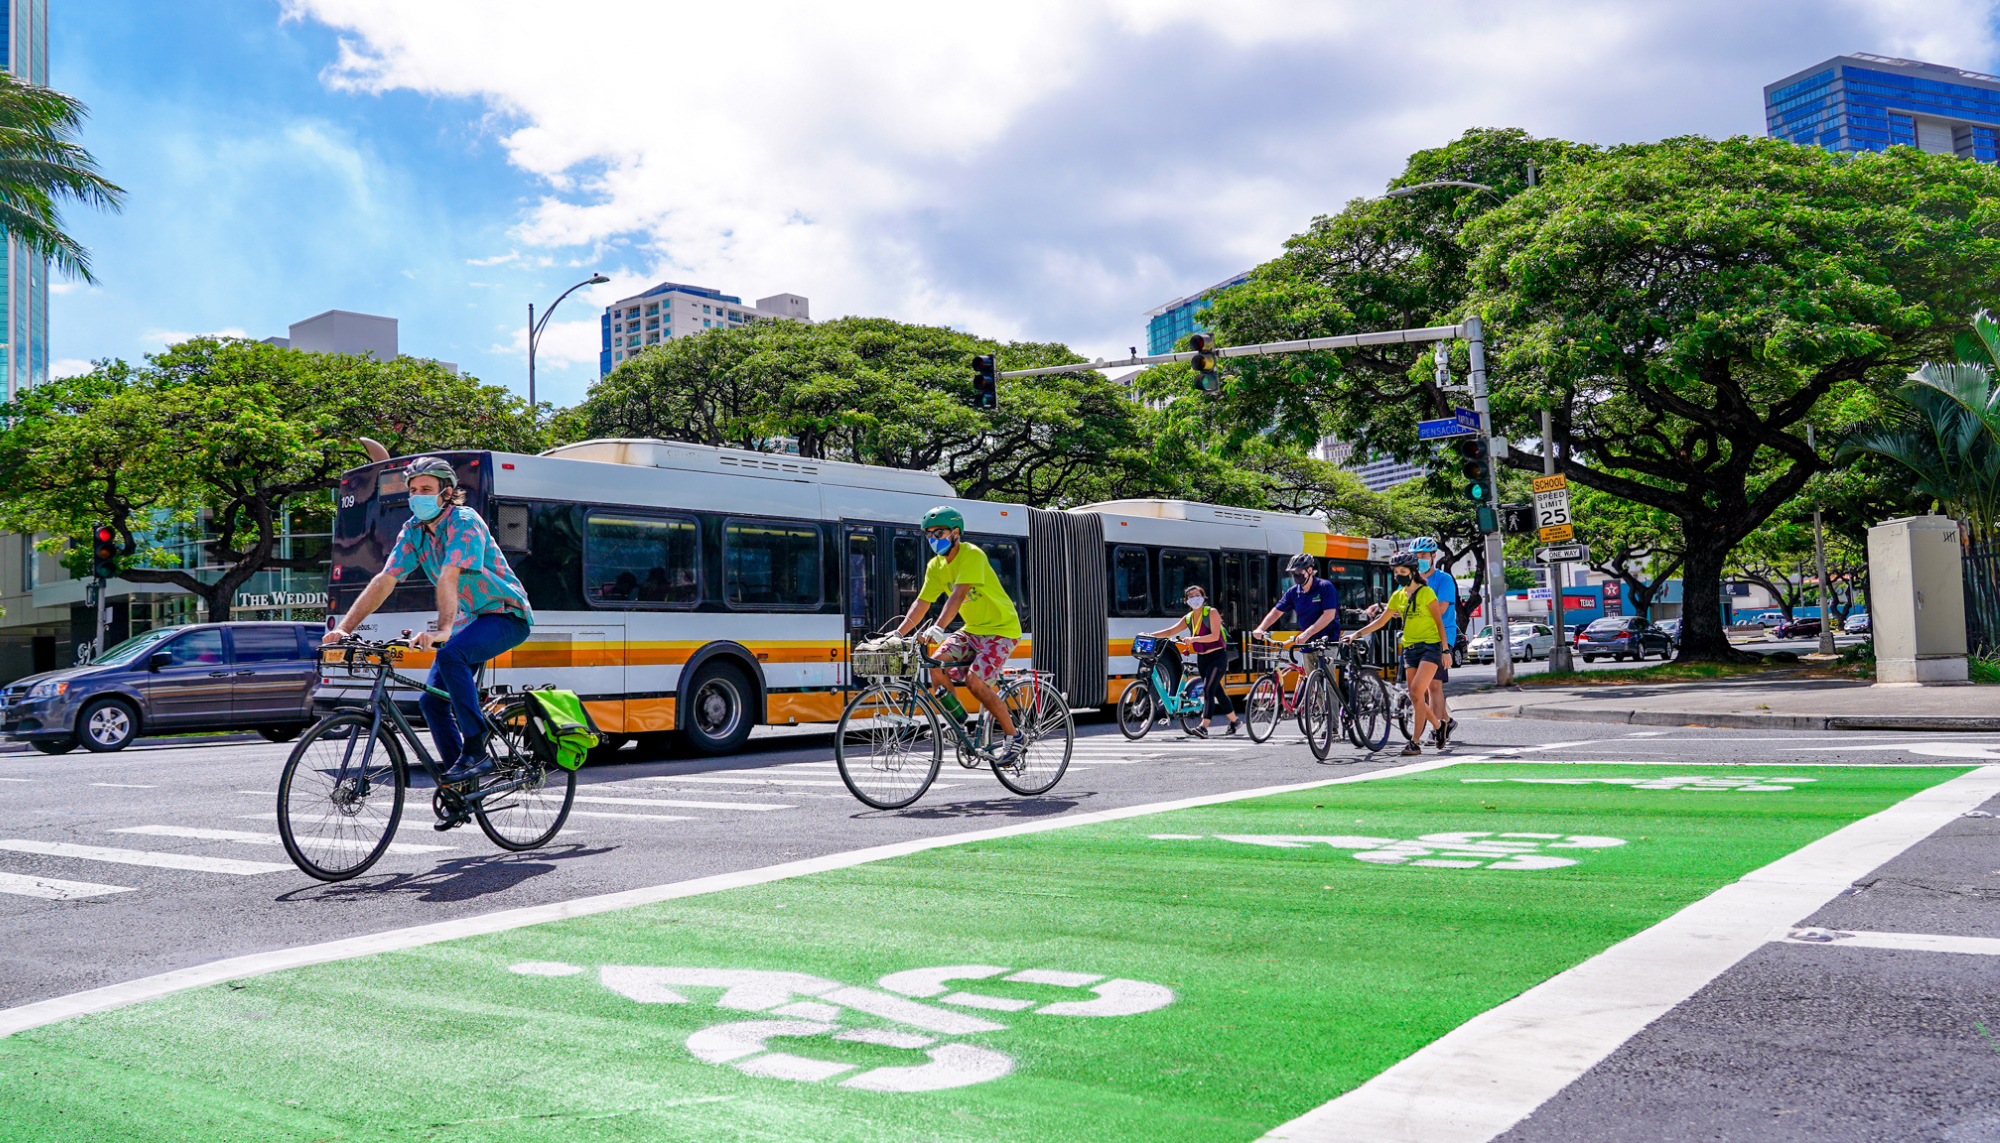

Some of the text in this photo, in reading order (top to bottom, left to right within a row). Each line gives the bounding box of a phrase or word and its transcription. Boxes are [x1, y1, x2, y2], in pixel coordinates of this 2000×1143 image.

[1534, 477, 1564, 490] SCHOOL
[341, 495, 355, 509] 109
[1537, 491, 1565, 502] SPEED
[1540, 500, 1563, 509] LIMIT
[1540, 508, 1567, 526] 25
[1548, 549, 1578, 559] ONE WAY
[239, 591, 329, 607] THE WEDDIN
[1579, 599, 1595, 607] TEXACO
